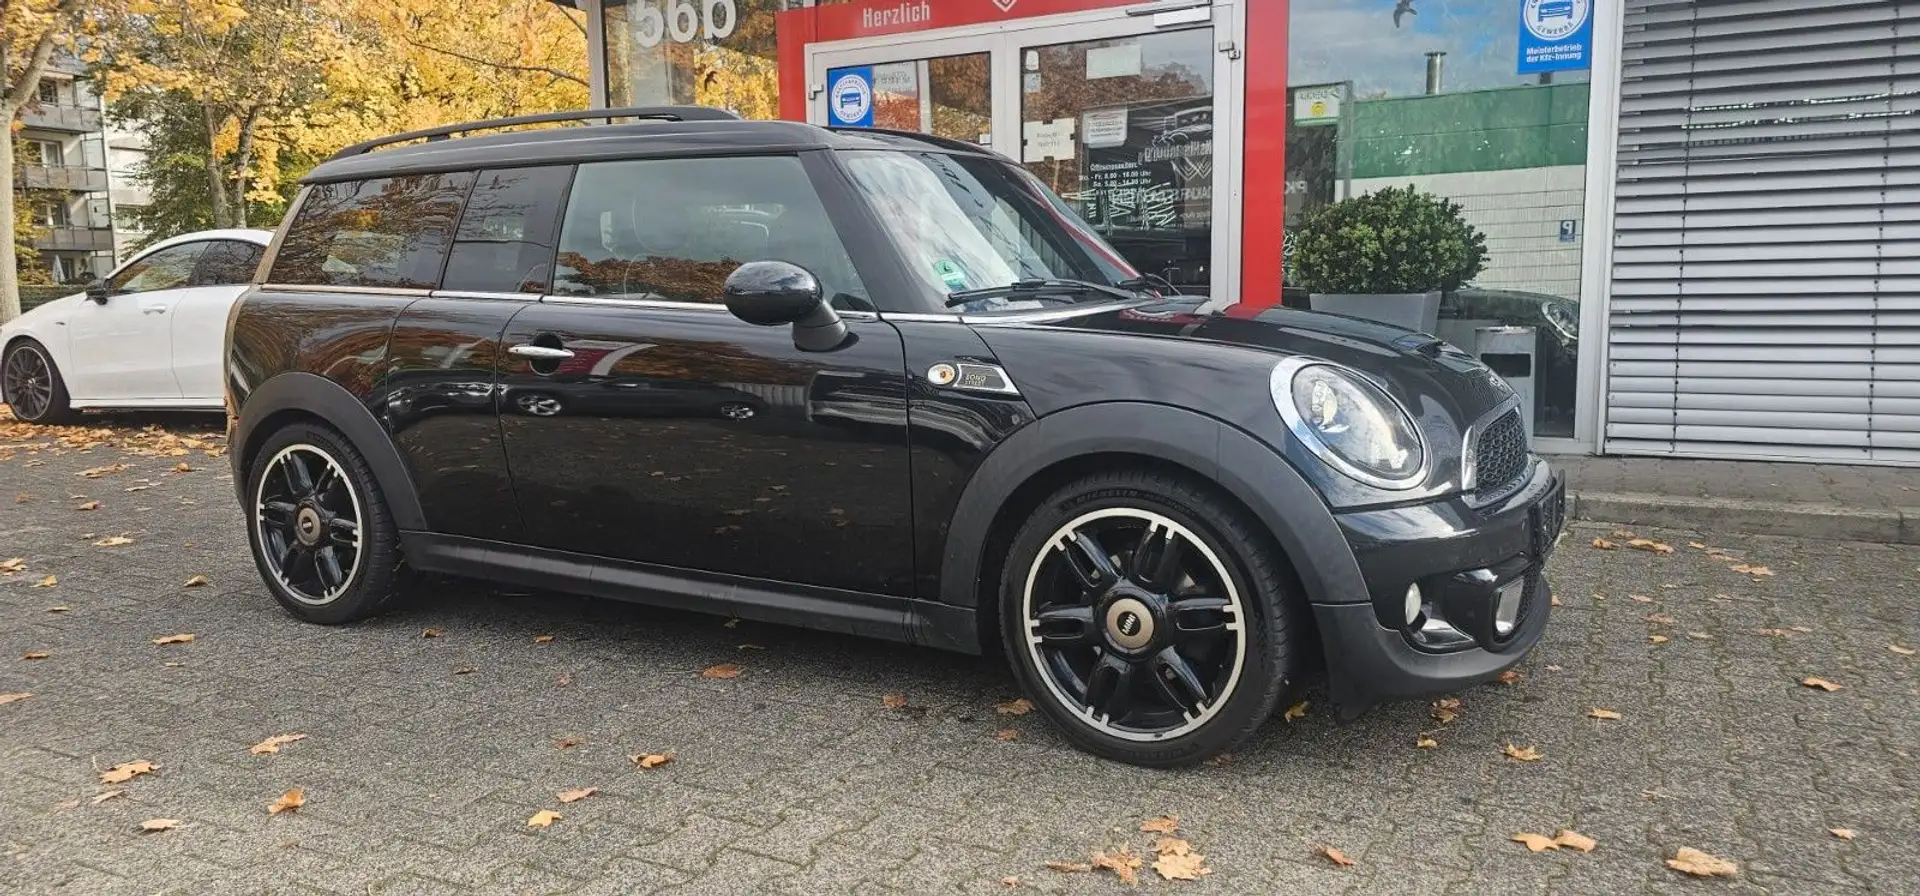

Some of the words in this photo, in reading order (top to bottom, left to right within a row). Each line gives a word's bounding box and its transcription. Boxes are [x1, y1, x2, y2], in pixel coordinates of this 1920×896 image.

[862, 2, 931, 28] Herzlich
[1526, 43, 1582, 55] Meisterbetrieb
[1526, 54, 1539, 63] der
[1540, 51, 1582, 62] Kfz-Innung
